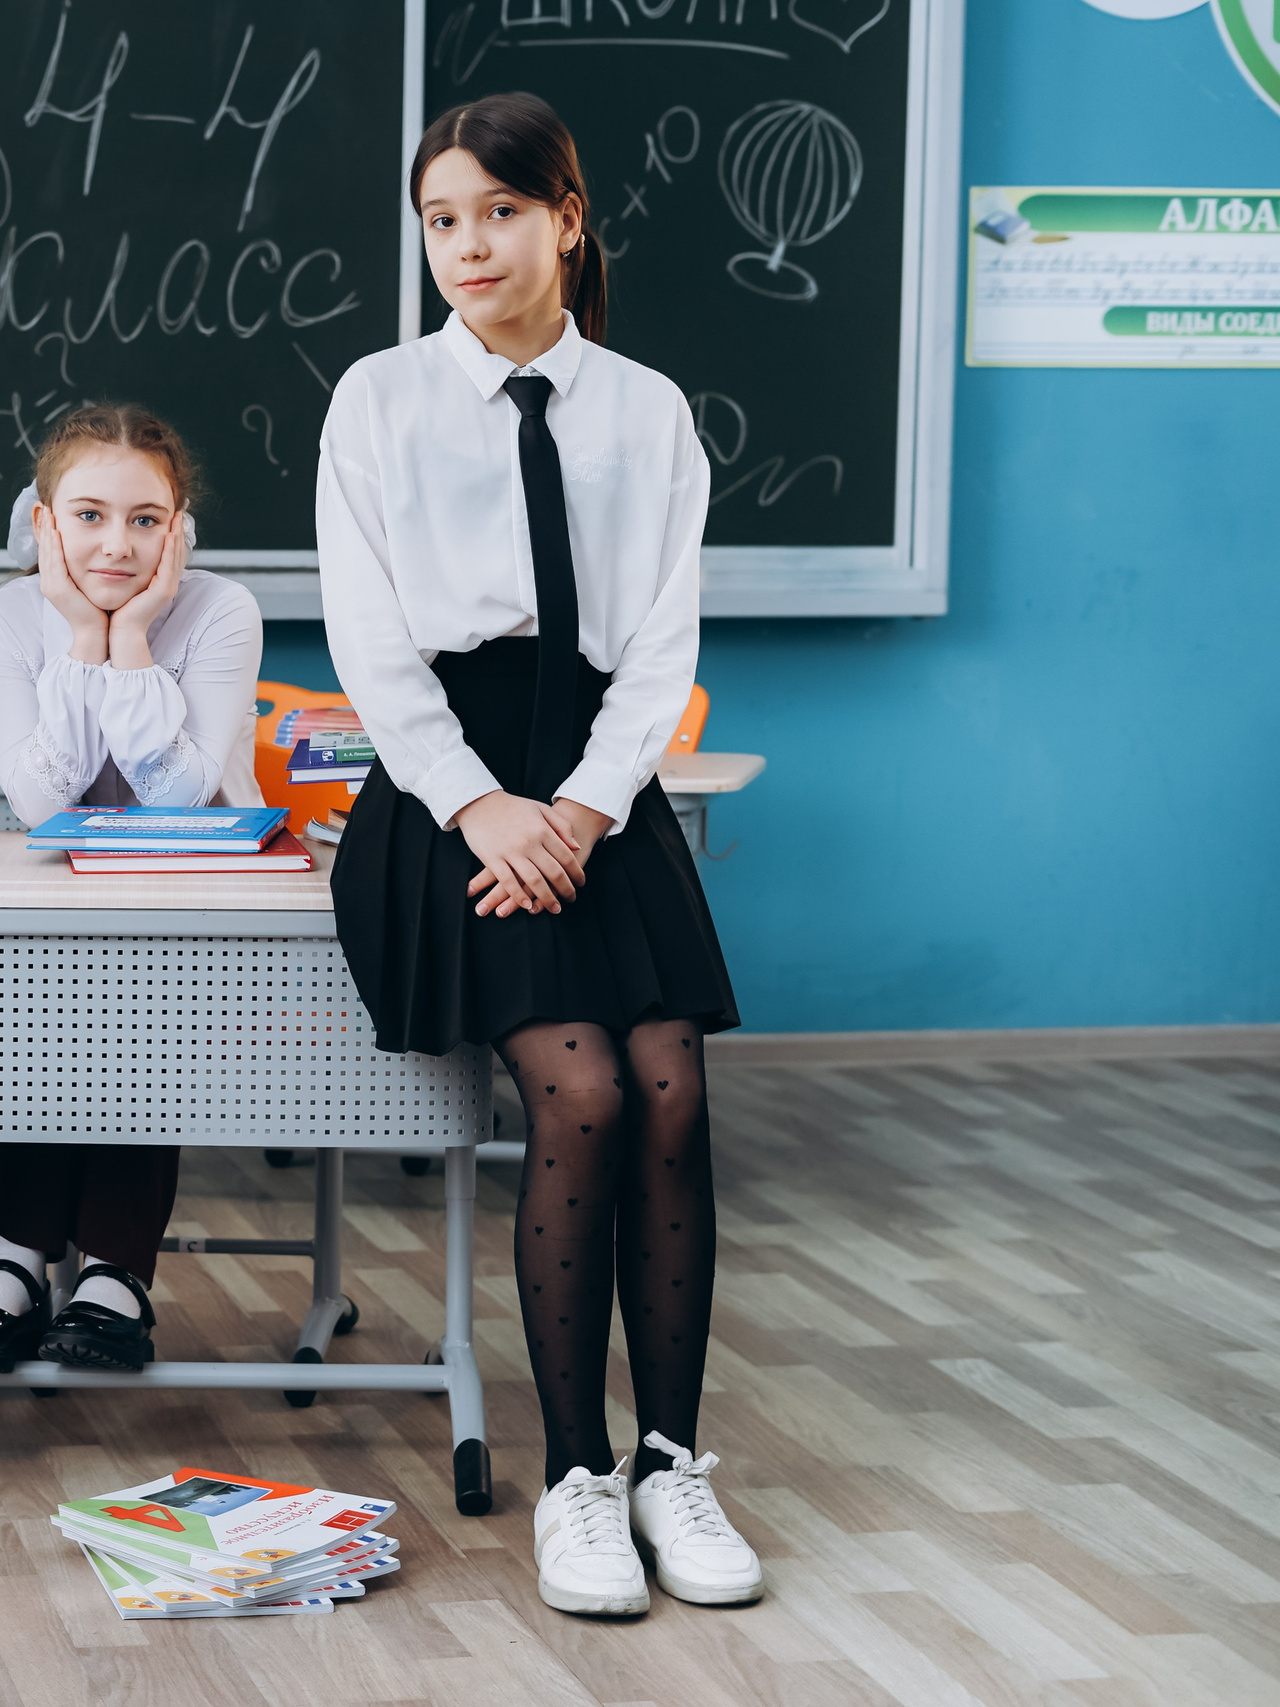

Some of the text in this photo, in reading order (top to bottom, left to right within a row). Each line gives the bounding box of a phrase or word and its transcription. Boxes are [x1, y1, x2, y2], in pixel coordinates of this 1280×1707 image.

[1158, 197, 1280, 232] АЛФА
[1218, 312, 1280, 337] СОЕД
[101, 1504, 187, 1533] 4
